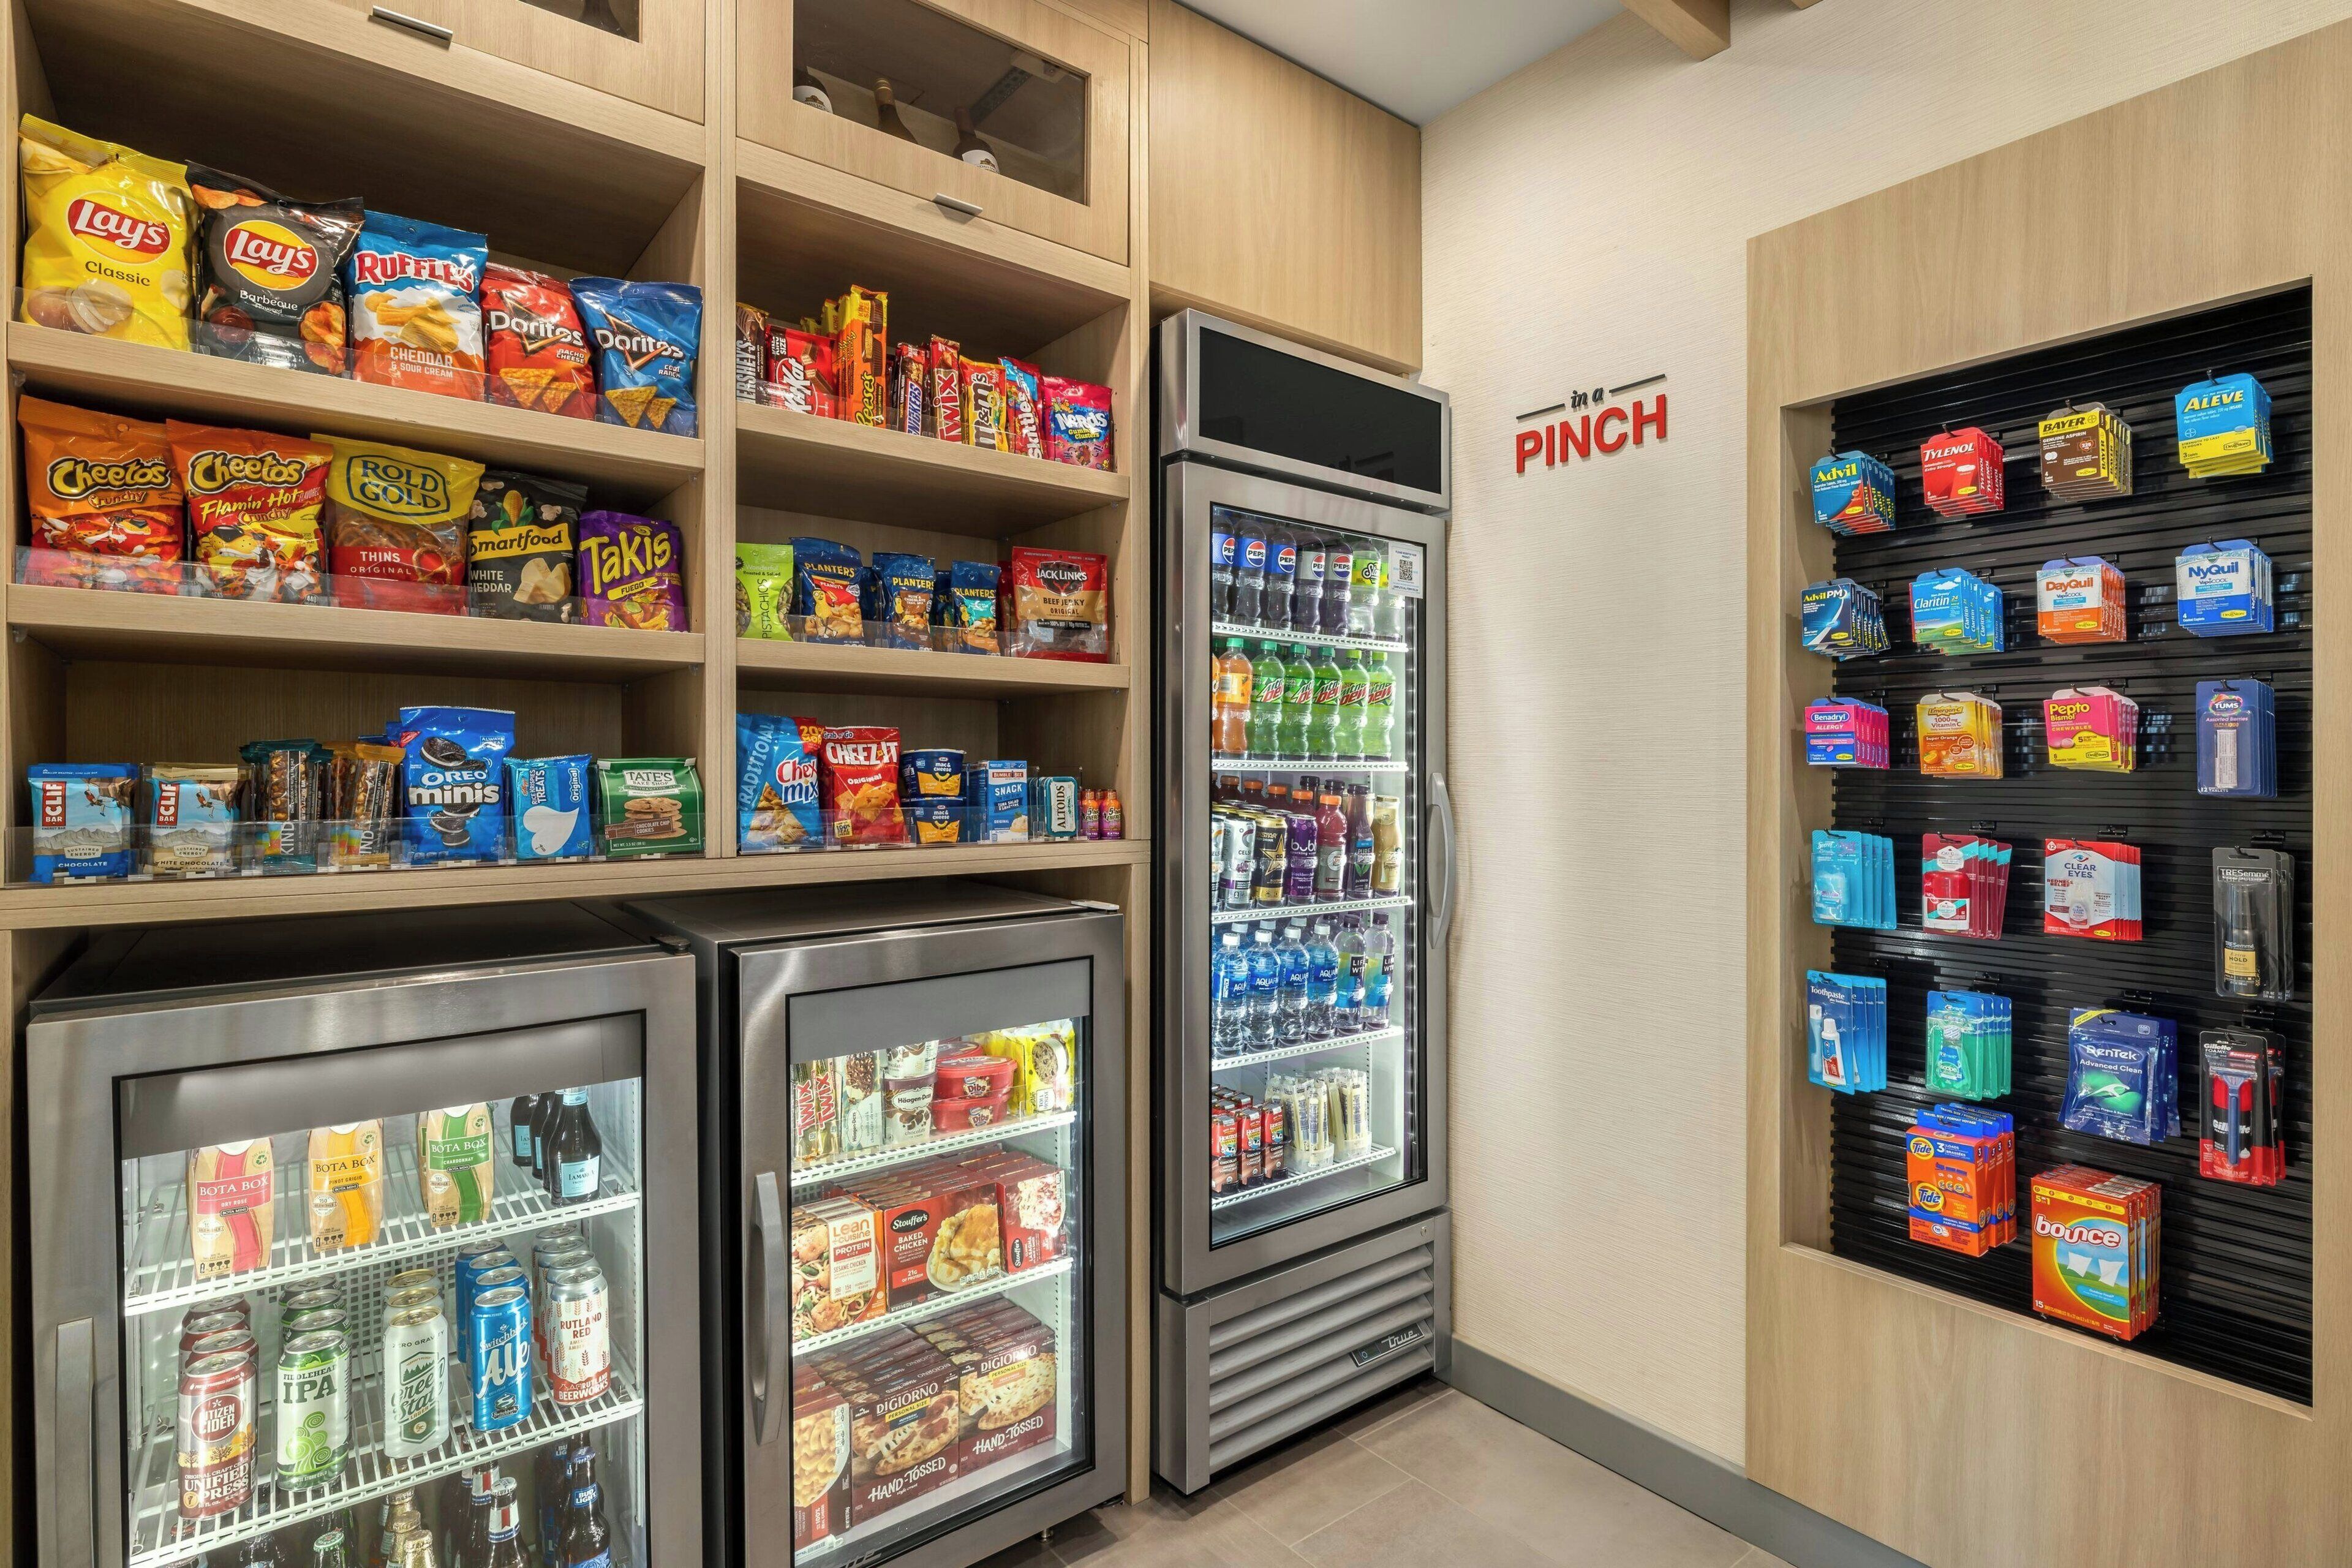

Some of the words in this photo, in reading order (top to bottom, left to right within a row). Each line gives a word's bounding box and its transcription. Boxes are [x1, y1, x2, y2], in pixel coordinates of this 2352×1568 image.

[74, 200, 168, 249] Lay's
[230, 230, 315, 276] Lay's
[85, 261, 151, 287] Classic
[355, 252, 474, 293] RUFFLES
[239, 290, 298, 312] Barbeque
[490, 311, 584, 346] Doritos
[595, 330, 685, 358] Doritos
[390, 346, 453, 368] CHEDDAR
[391, 361, 397, 370] &
[401, 362, 421, 374] SOUR
[424, 366, 453, 379] CREAM
[1570, 390, 1588, 408] in
[1593, 387, 1604, 402] a
[2184, 390, 2243, 412] ALEVE
[1517, 394, 1666, 473] PINCH
[2043, 417, 2085, 432] BAYER
[1923, 443, 1975, 461] TYLENOL
[53, 459, 168, 494] Cheetos
[190, 451, 305, 492] Cheetos
[361, 459, 439, 492] ROLD
[1815, 463, 1857, 483] Advil
[88, 491, 146, 507] Crunchy
[359, 483, 440, 508] GOLD
[200, 496, 262, 524] Flamin'
[270, 489, 300, 508] Hot
[239, 507, 292, 525] Crunchy
[360, 551, 401, 562] THINS
[580, 530, 671, 594] Takis
[350, 566, 412, 575] ORIGINAL
[805, 563, 855, 578] PLANTERS
[1036, 568, 1058, 579] JACK
[1060, 570, 1087, 581] LINK'S
[2188, 562, 2239, 579] NyQuil
[622, 582, 644, 594] FUEGO
[2046, 582, 2094, 592] DayQuil
[758, 579, 772, 638] PISTACHIOS
[1914, 596, 1949, 609] Claritin
[2049, 703, 2090, 715] Pepto
[626, 772, 672, 782] TATE'S
[739, 723, 774, 811] TRADITIONAL
[777, 760, 817, 783] Chex
[421, 771, 487, 785] OREO
[536, 770, 546, 803] TREATS
[571, 769, 579, 801] Original
[45, 783, 62, 816] CLIF
[160, 783, 178, 815] CLIF
[409, 783, 499, 805] minis
[784, 779, 818, 800] mix
[995, 785, 1022, 796] SNACK
[1056, 786, 1066, 828] ALTOIDS
[281, 822, 295, 855] KIND
[1811, 986, 1845, 1000] Toothpaste
[2080, 1059, 2117, 1070] Advanced
[432, 1144, 461, 1154] BOTA
[464, 1137, 486, 1150] BOX
[1913, 1143, 1932, 1153] Tide
[1937, 1143, 1944, 1153] 3
[316, 1162, 347, 1173] BOTA
[352, 1155, 375, 1168] BOX
[200, 1184, 238, 1196] BOTA
[242, 1176, 269, 1190] BOX
[1918, 1188, 1940, 1203] Tide
[893, 1213, 928, 1230] Stouffer's
[2036, 1215, 2120, 1247] bounce
[894, 1238, 928, 1253] CHICKEN
[899, 1232, 923, 1243] BAKED
[835, 1242, 870, 1256] PROTEIN
[834, 1263, 850, 1273] SESAME
[850, 1261, 866, 1269] CHICKEN
[560, 1312, 601, 1331] RUTLAND
[573, 1327, 591, 1338] RED
[477, 1340, 530, 1399] Ale
[992, 1366, 1014, 1379] PERSONAL
[1016, 1360, 1027, 1371] SIZE
[283, 1374, 337, 1404] IPA
[559, 1380, 608, 1401] BEERWORKS
[888, 1405, 914, 1421] PERSONAL
[916, 1398, 927, 1409] SIZE
[973, 1415, 1044, 1455] HAND-TOSSED
[184, 1463, 249, 1491] UNIFIED
[212, 1466, 233, 1476] CRAFT
[868, 1457, 946, 1503] HAND-TOSSED
[199, 1476, 249, 1499] PRESS
[578, 1488, 594, 1498] BUD
[576, 1493, 597, 1504] LIGHT
